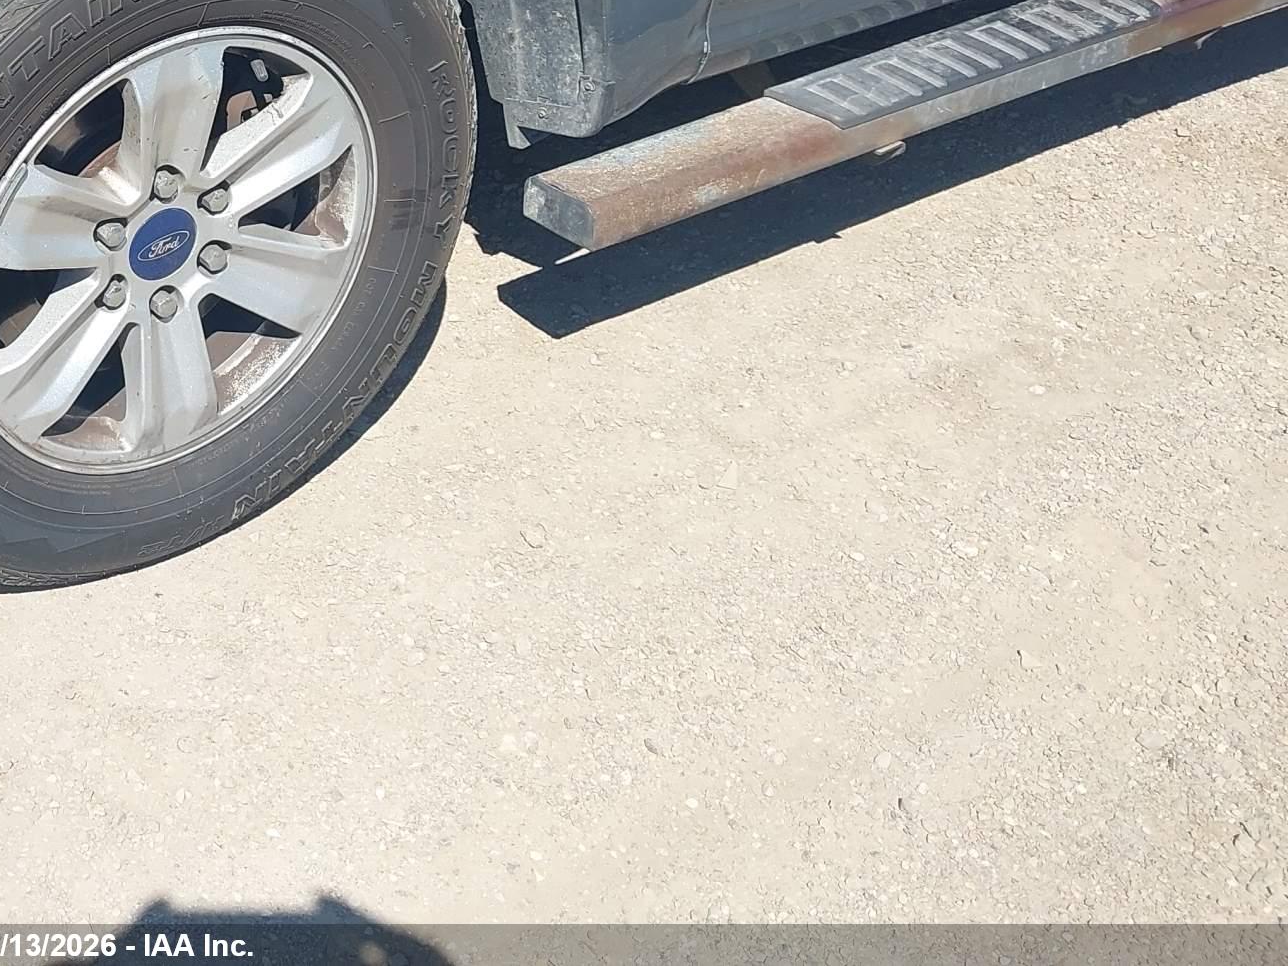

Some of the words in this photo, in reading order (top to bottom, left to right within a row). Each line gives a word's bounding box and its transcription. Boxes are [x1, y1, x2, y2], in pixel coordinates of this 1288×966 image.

[427, 60, 460, 240] ROCKY
[148, 235, 180, 258] Ford
[231, 260, 439, 521] MOUNTAIN
